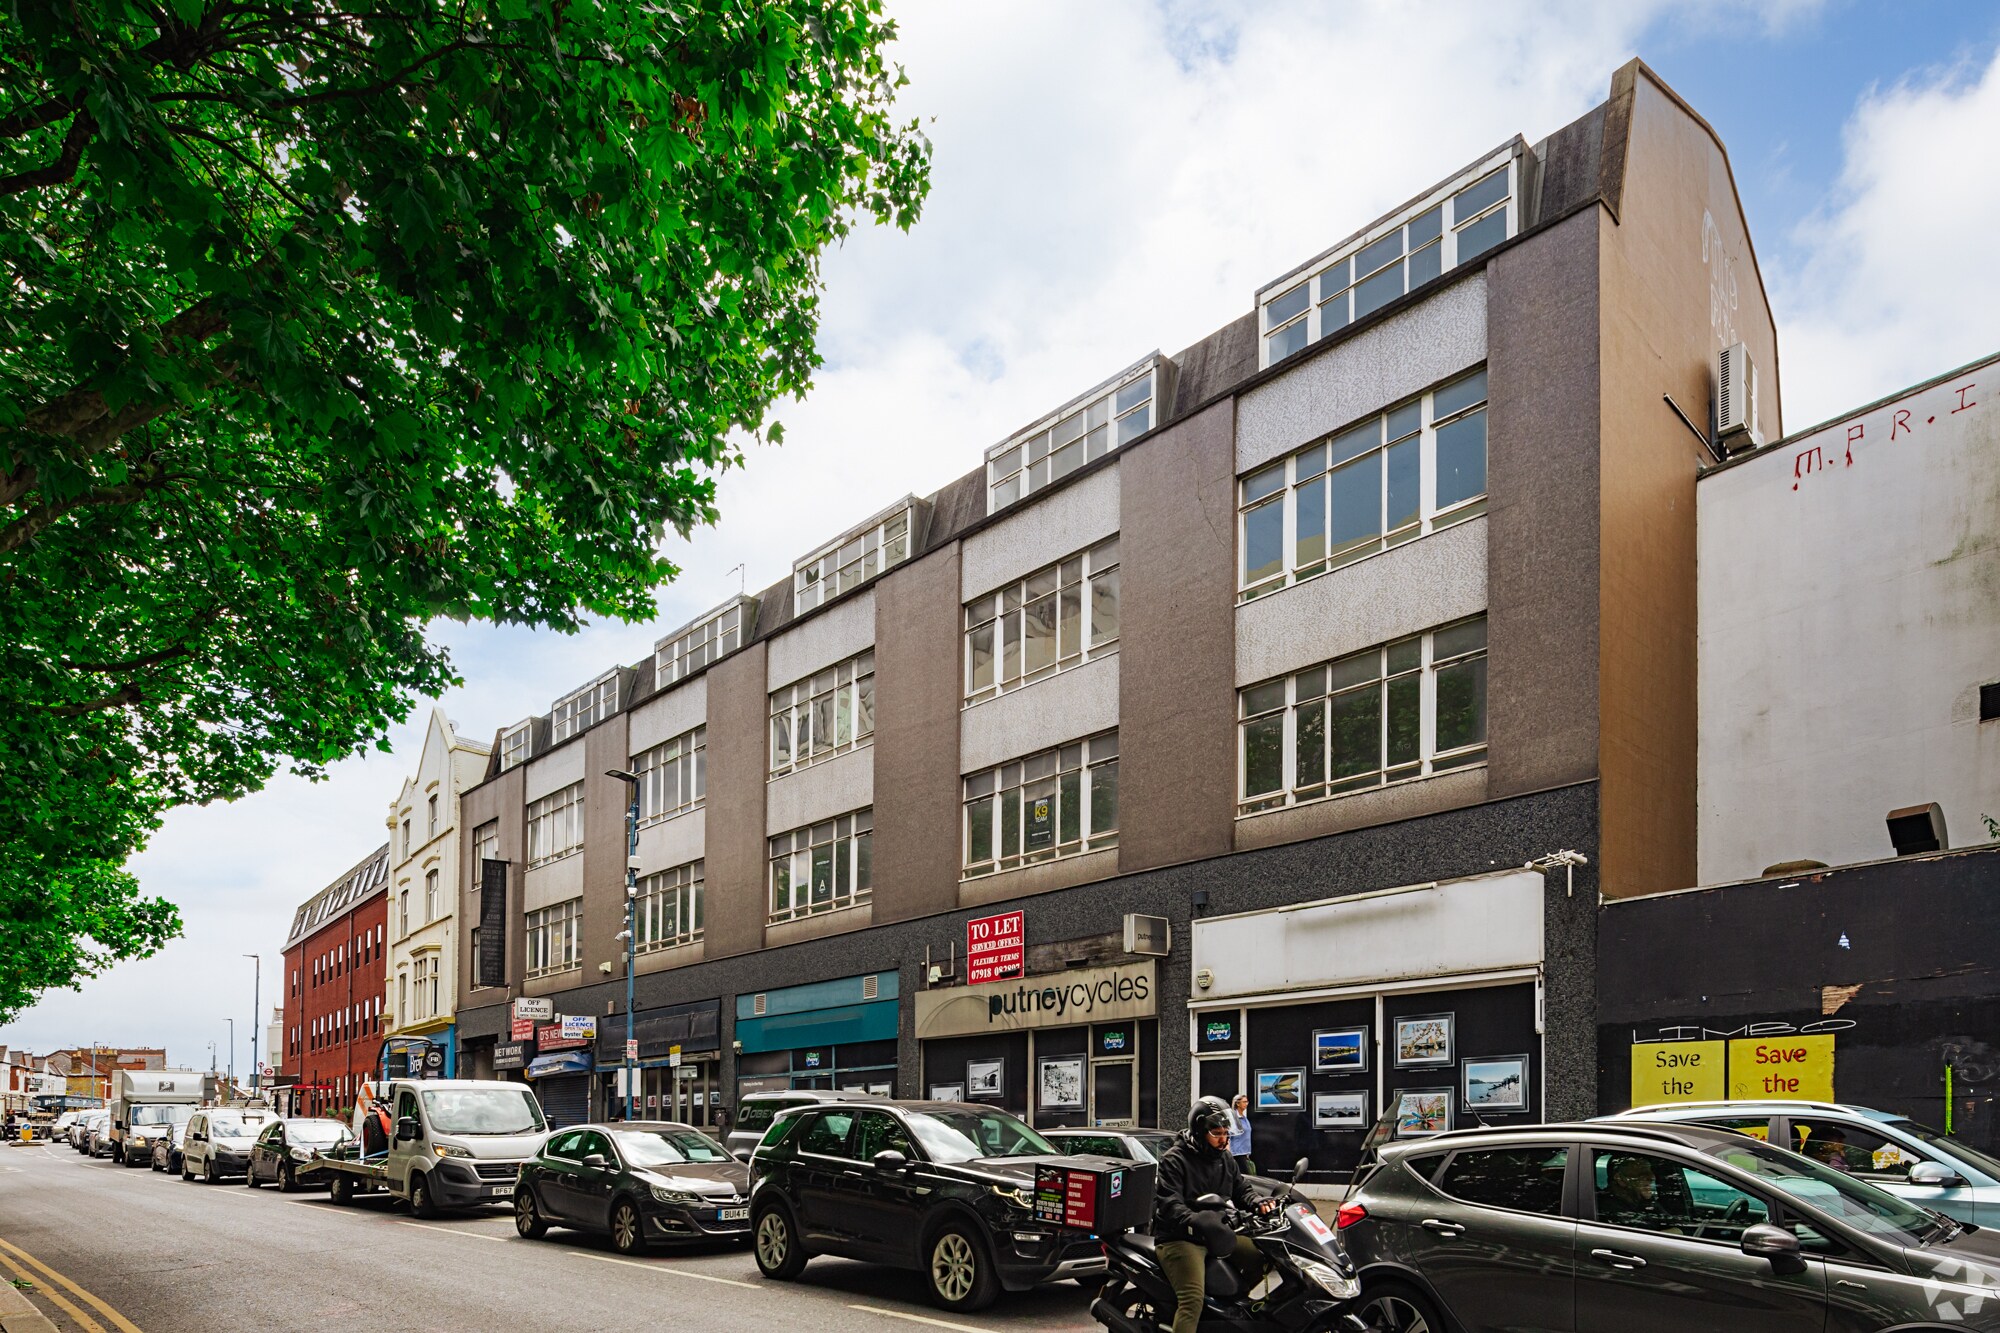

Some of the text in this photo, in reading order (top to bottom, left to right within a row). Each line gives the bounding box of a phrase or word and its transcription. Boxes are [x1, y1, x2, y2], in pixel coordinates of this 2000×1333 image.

[1035, 806, 1048, 817] K9
[971, 916, 1020, 940] TO LET
[971, 936, 1020, 952] SERVICED OFFICES
[972, 952, 1020, 967] FLEXIBLE TERMS
[971, 968, 992, 980] 07918
[988, 971, 1149, 1023] putneycycles
[519, 1006, 549, 1014] LICENCE
[564, 1031, 582, 1039] oyster
[1633, 1019, 1857, 1045] LIMBO
[494, 1046, 522, 1057] NETWORK
[1656, 1050, 1701, 1068] Save
[1755, 1045, 1808, 1064] Save
[1661, 1077, 1695, 1095] the
[1762, 1073, 1800, 1093] the
[750, 1109, 776, 1119] OBEX
[1308, 1220, 1327, 1236] L
